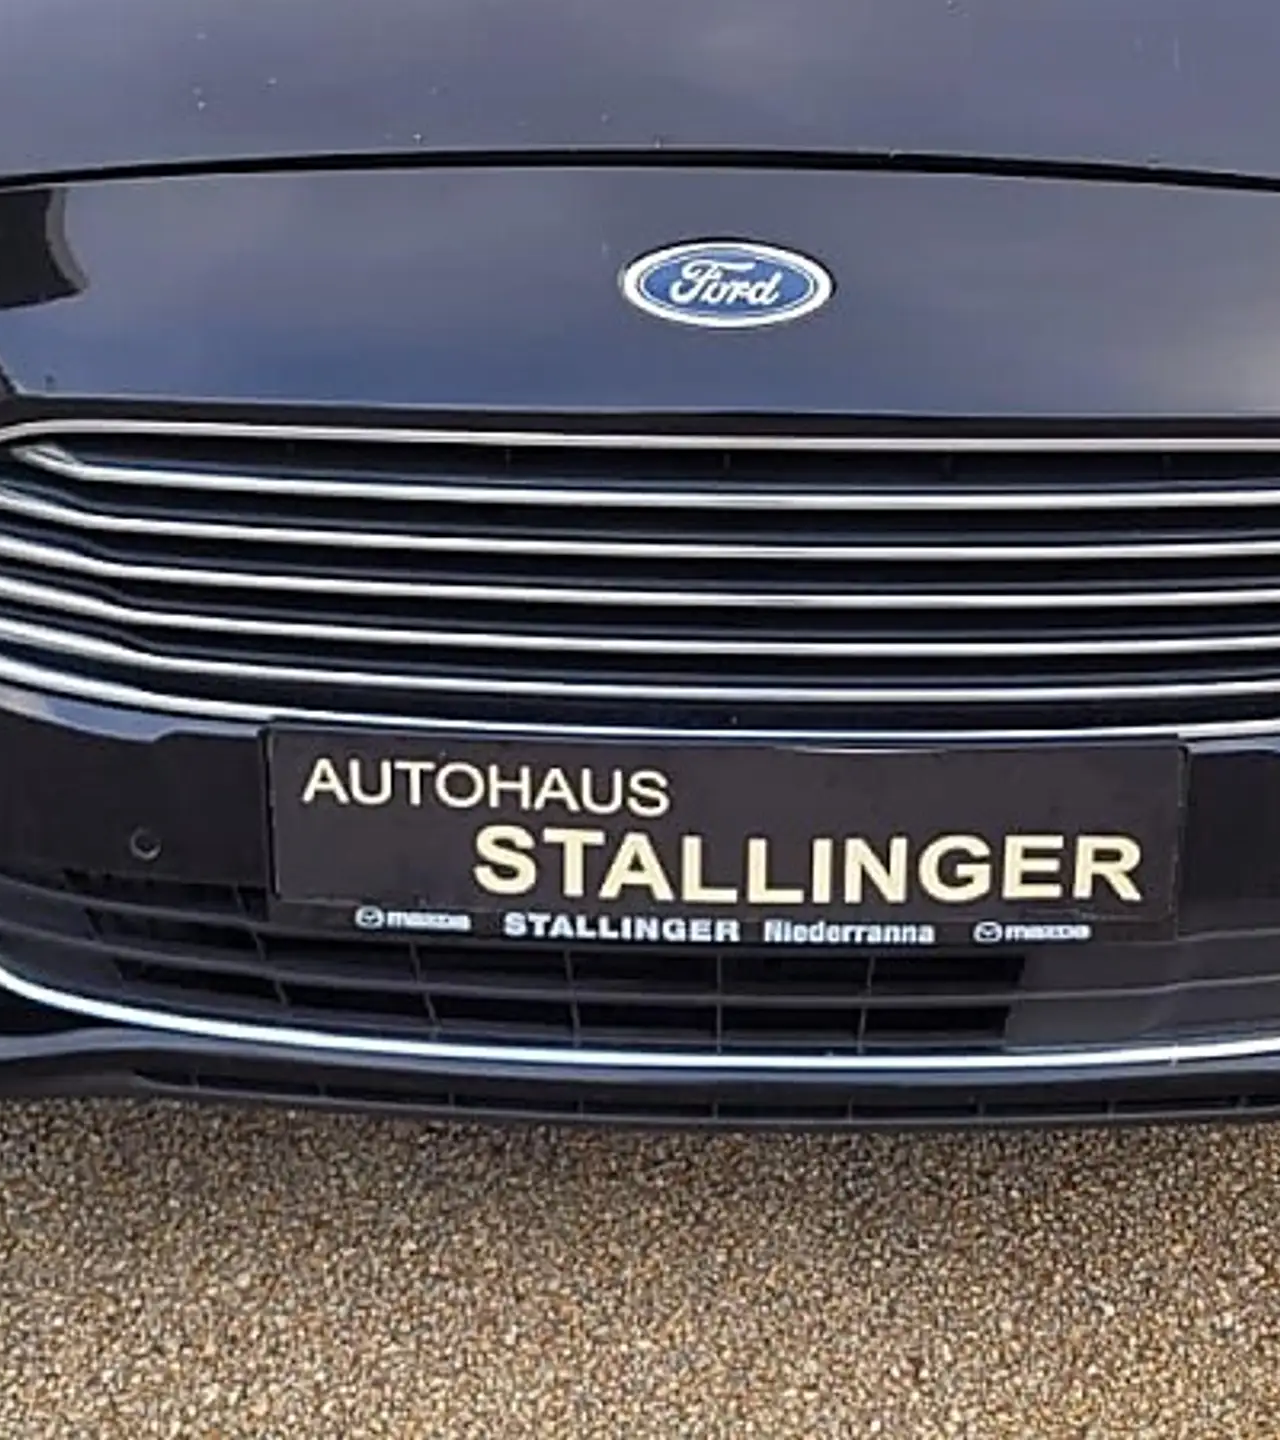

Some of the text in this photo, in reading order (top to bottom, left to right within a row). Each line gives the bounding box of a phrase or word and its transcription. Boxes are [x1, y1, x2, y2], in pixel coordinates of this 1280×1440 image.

[670, 259, 782, 305] Ford
[302, 757, 671, 817] AUTOHAUS
[473, 824, 1142, 905] STALLINGER
[503, 911, 741, 943] STALLINGER
[763, 917, 936, 945] Niederranna
